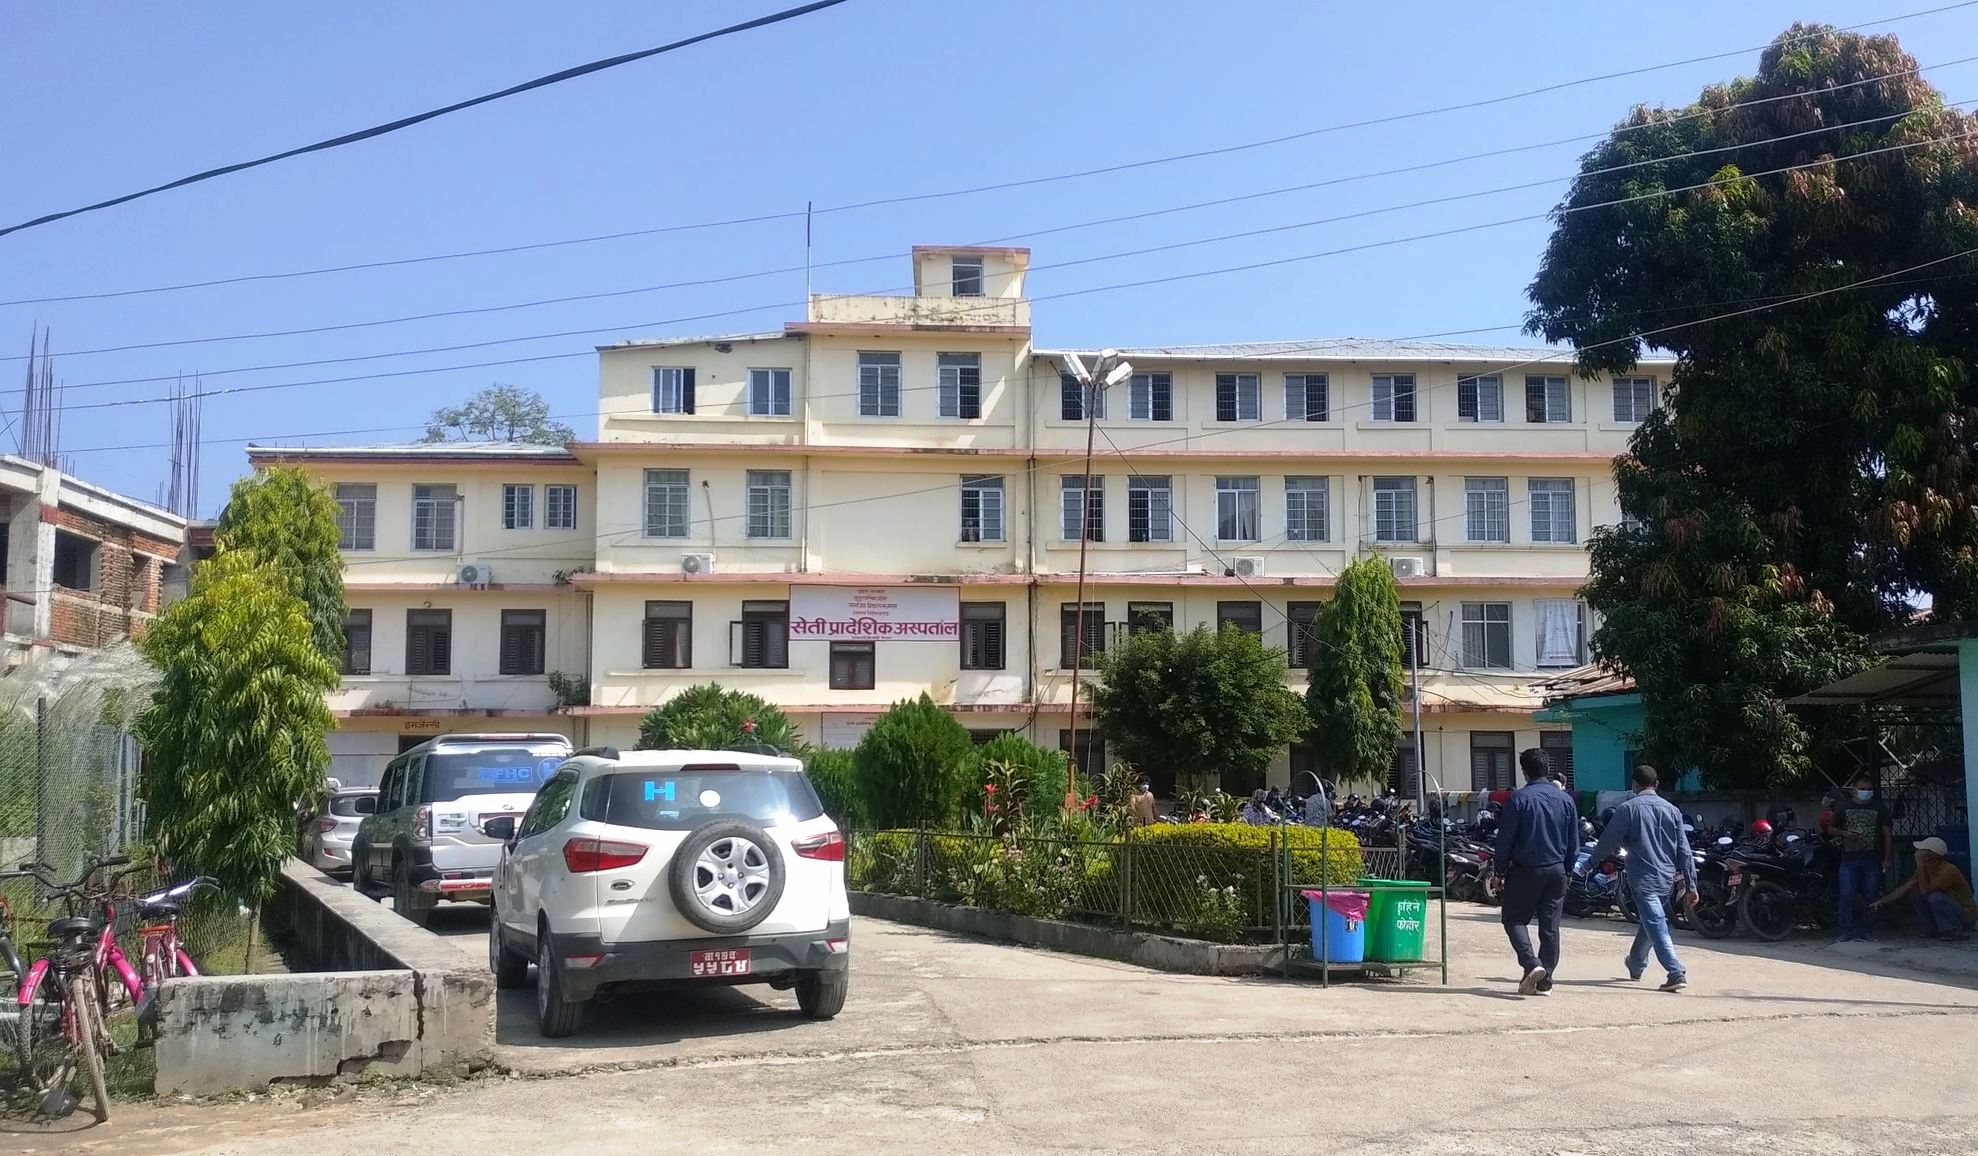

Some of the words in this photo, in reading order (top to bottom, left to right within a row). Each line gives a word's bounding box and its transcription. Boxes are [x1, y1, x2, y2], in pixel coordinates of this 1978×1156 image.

[791, 616, 826, 635] सेती
[829, 616, 893, 636] प्रादेशिक
[893, 620, 958, 636] अस्पताल
[645, 781, 675, 801] H
